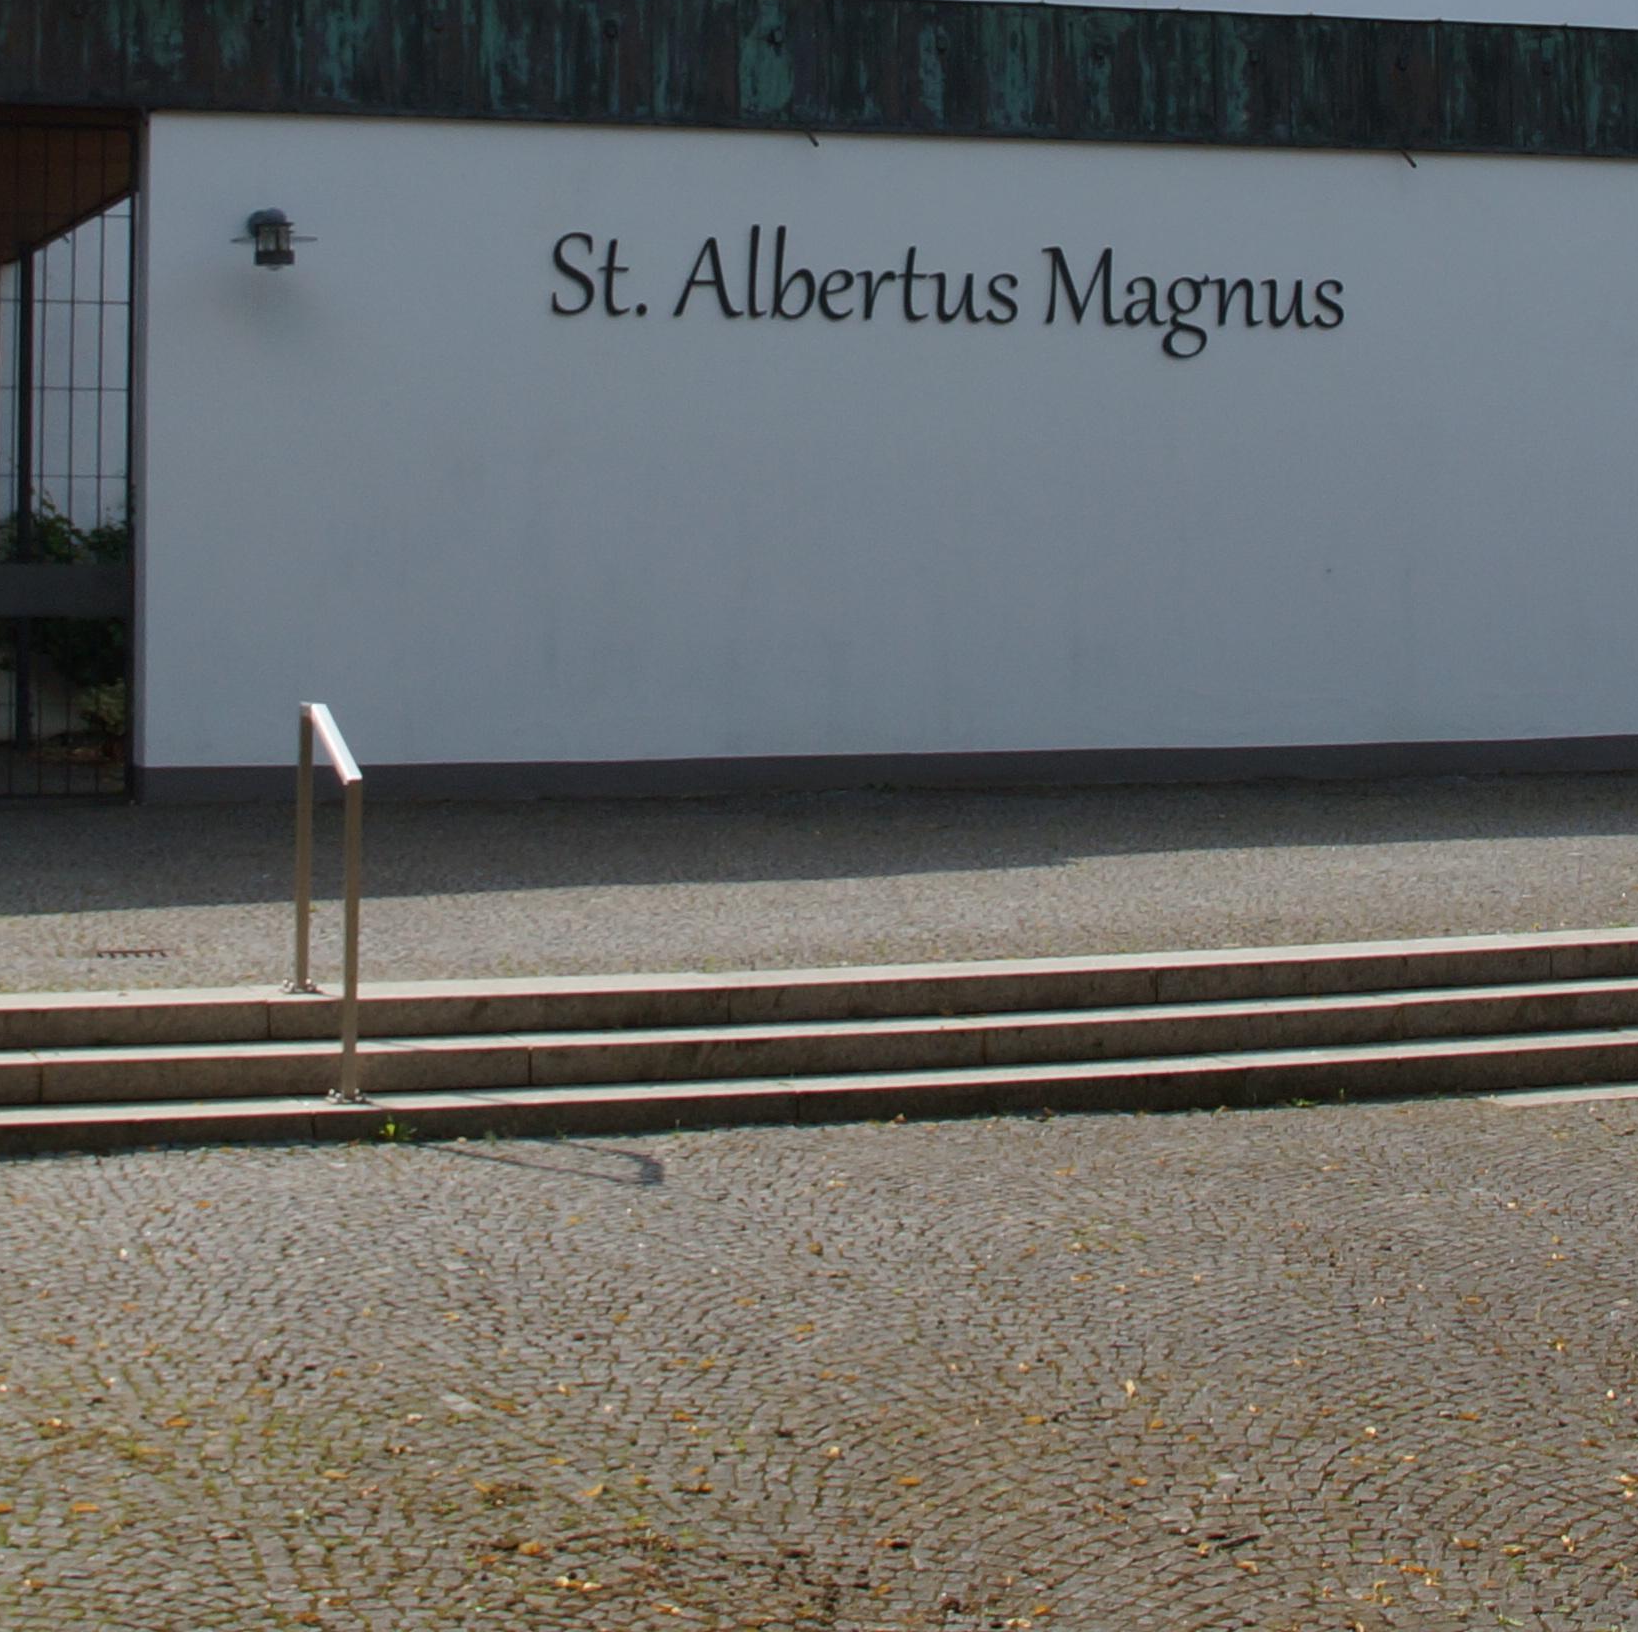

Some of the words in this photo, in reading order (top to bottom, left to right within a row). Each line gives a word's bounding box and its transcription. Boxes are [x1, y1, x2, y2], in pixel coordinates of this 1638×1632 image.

[549, 231, 649, 320] St.
[671, 224, 1019, 327] Albertus
[1040, 245, 1345, 361] Magnus
